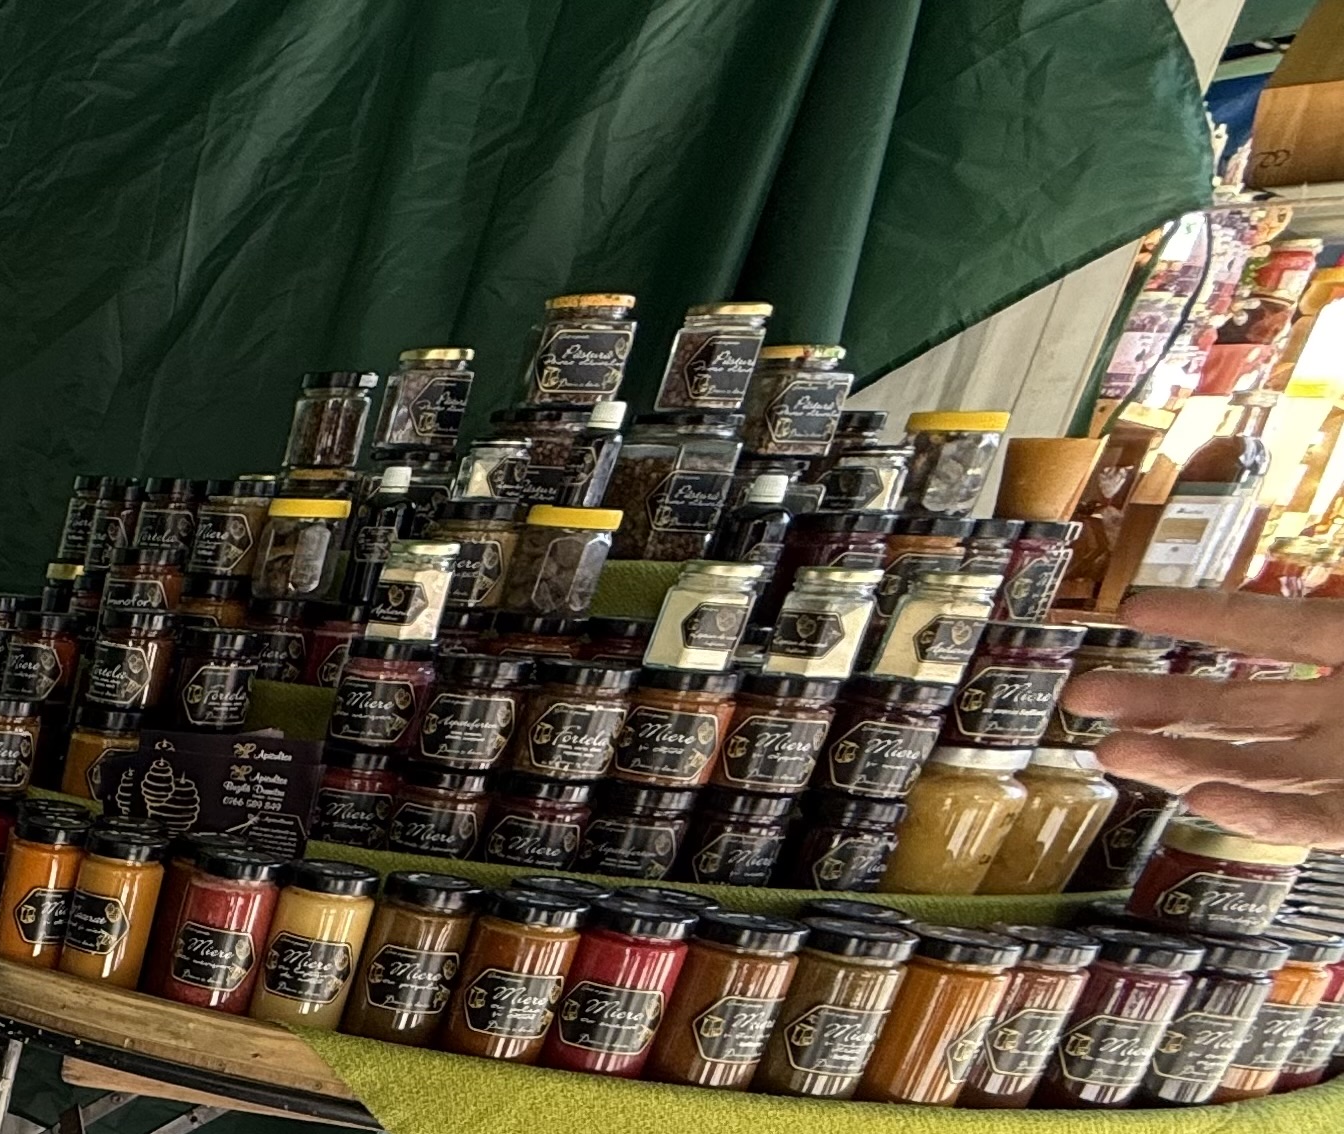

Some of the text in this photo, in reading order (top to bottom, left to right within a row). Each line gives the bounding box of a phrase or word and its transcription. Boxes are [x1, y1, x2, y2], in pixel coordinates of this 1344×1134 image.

[346, 691, 393, 710] Miere
[639, 722, 696, 744] Miere
[756, 732, 811, 752] Miere
[865, 738, 921, 760] Miere
[187, 937, 234, 960] Miere
[283, 949, 332, 971] Miere
[390, 962, 441, 982] Miere
[492, 986, 548, 1006] Miere
[585, 998, 644, 1021] Miere
